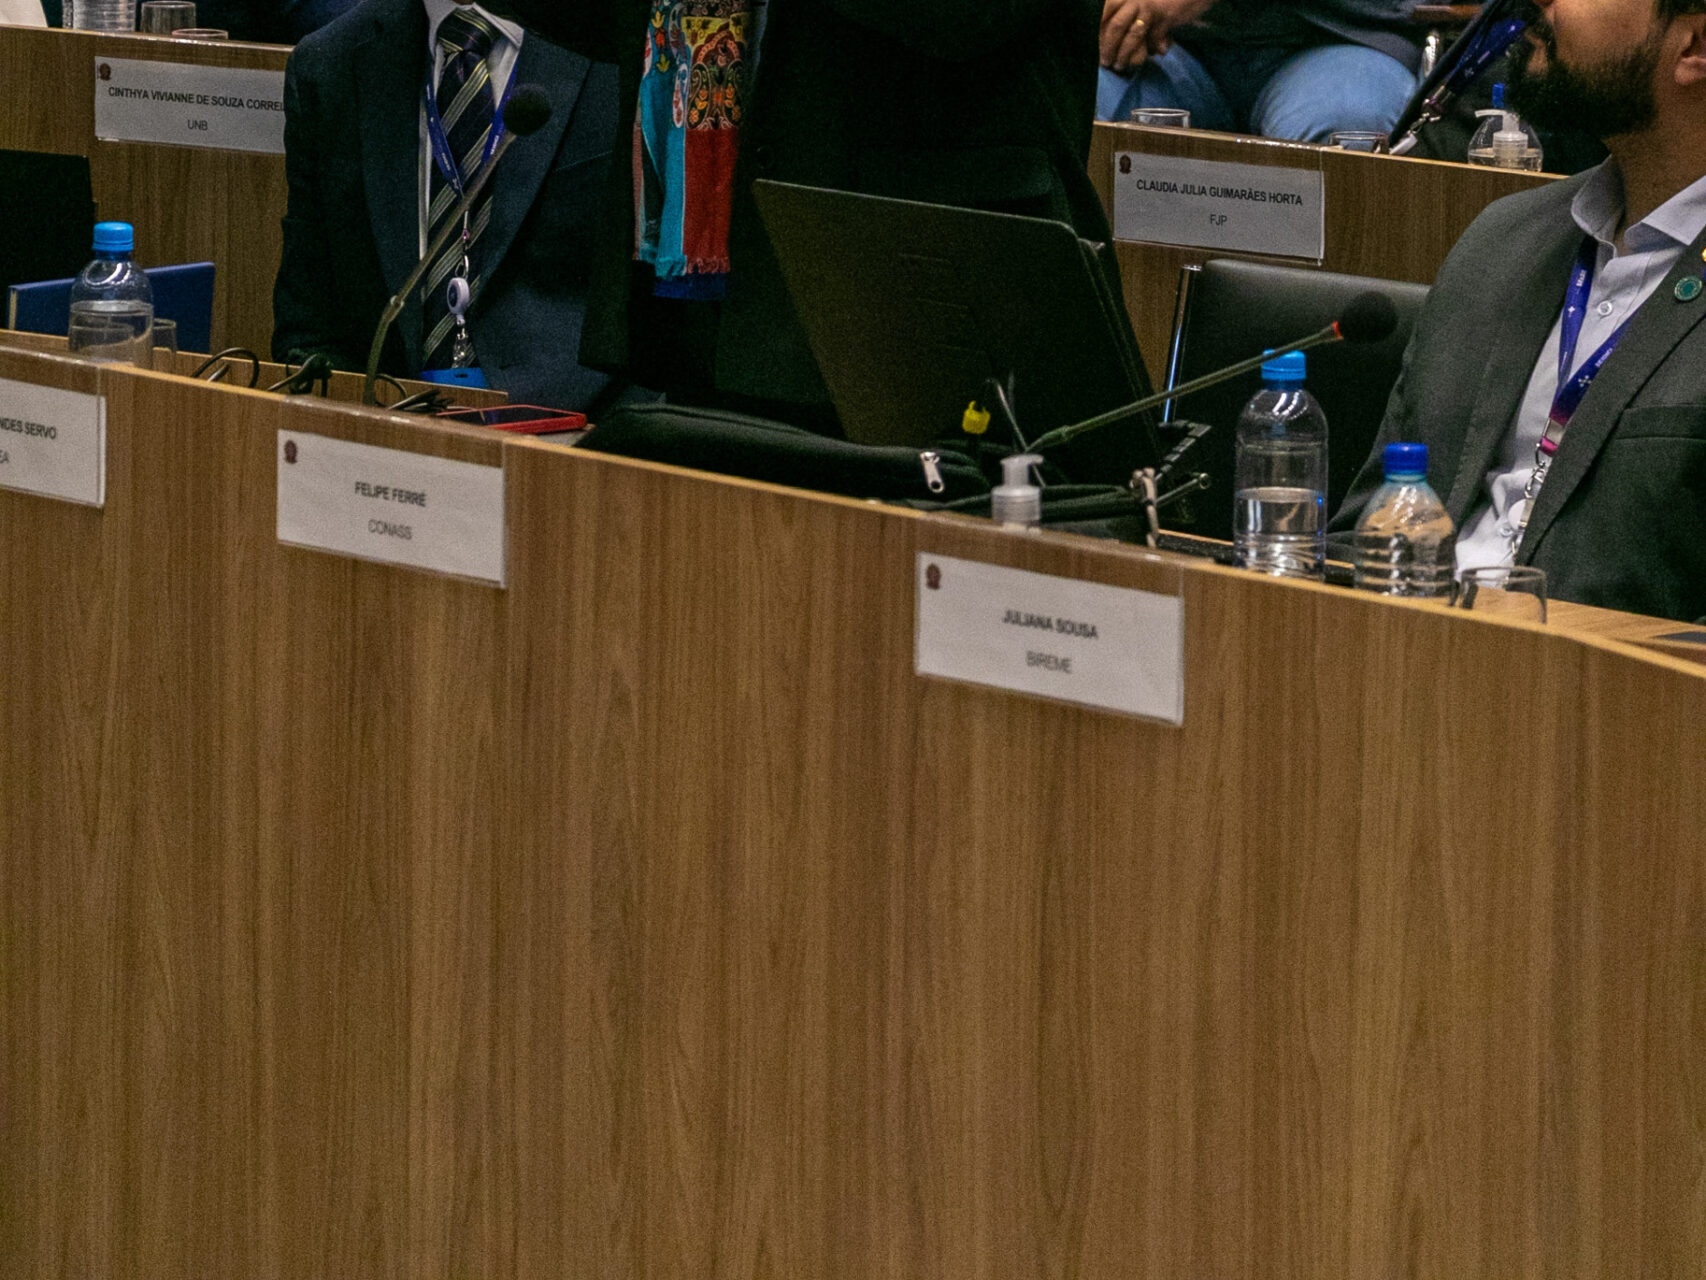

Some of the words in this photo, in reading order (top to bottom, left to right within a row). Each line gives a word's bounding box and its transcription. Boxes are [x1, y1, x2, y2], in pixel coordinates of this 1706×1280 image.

[108, 86, 149, 100] CINTHYA
[150, 89, 194, 104] VIVIANNE
[196, 94, 209, 105] DE
[211, 96, 244, 108] SOUZA
[246, 98, 284, 112] CORREI
[187, 119, 208, 131] UNB
[1136, 179, 1178, 193] CLAUDIA
[1180, 184, 1207, 196] JULIA
[1209, 186, 1266, 202] GUIMARÃES
[1268, 192, 1303, 205] HORTA
[1209, 214, 1228, 226] FJP
[24, 421, 57, 440] SERVO
[354, 481, 389, 500] FELIPE
[367, 519, 413, 540] CONASS
[1003, 609, 1053, 631] JULIANA
[1055, 617, 1098, 639] SOUSA
